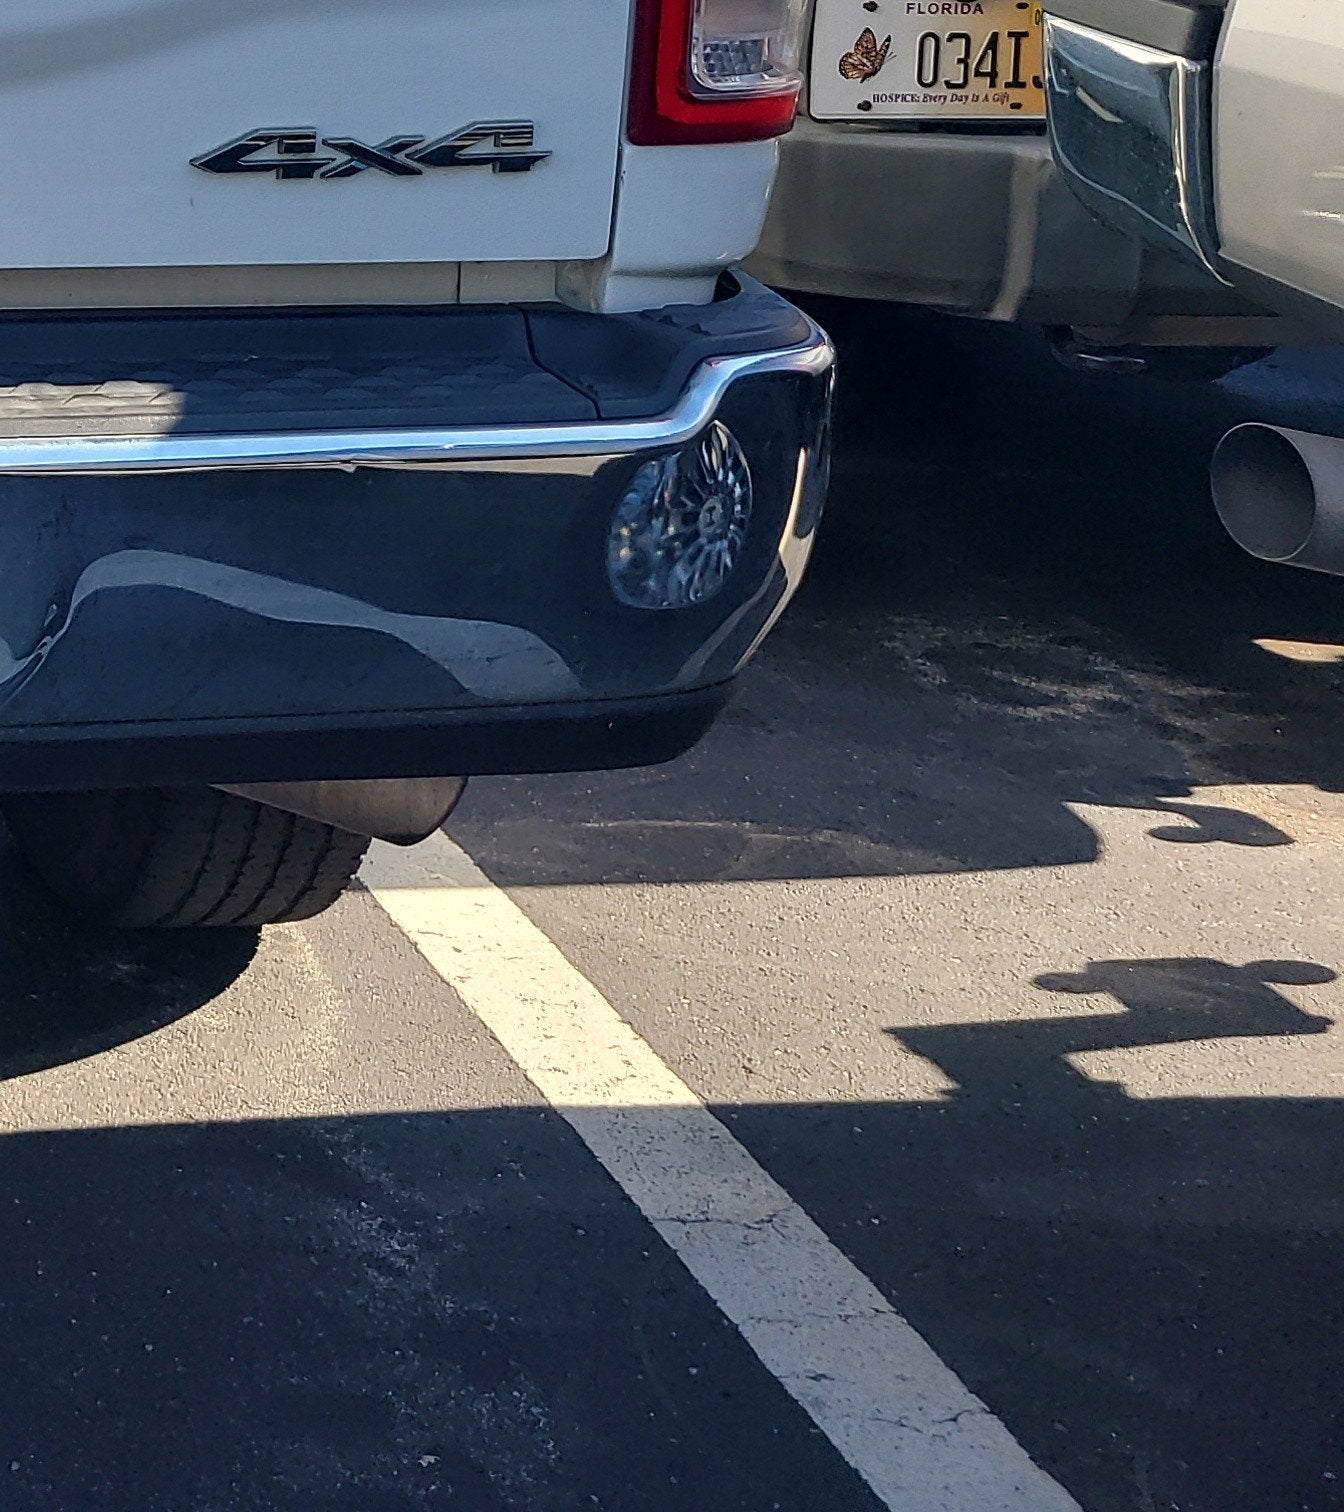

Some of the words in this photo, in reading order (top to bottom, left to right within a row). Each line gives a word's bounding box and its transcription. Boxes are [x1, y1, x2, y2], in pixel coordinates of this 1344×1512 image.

[906, 2, 984, 15] FLORIDA
[915, 30, 1043, 89] 034I
[872, 93, 919, 103] HOSPICE:
[921, 93, 947, 105] Every
[950, 93, 969, 104] Day
[982, 93, 989, 102] A
[992, 92, 1010, 105] Gift
